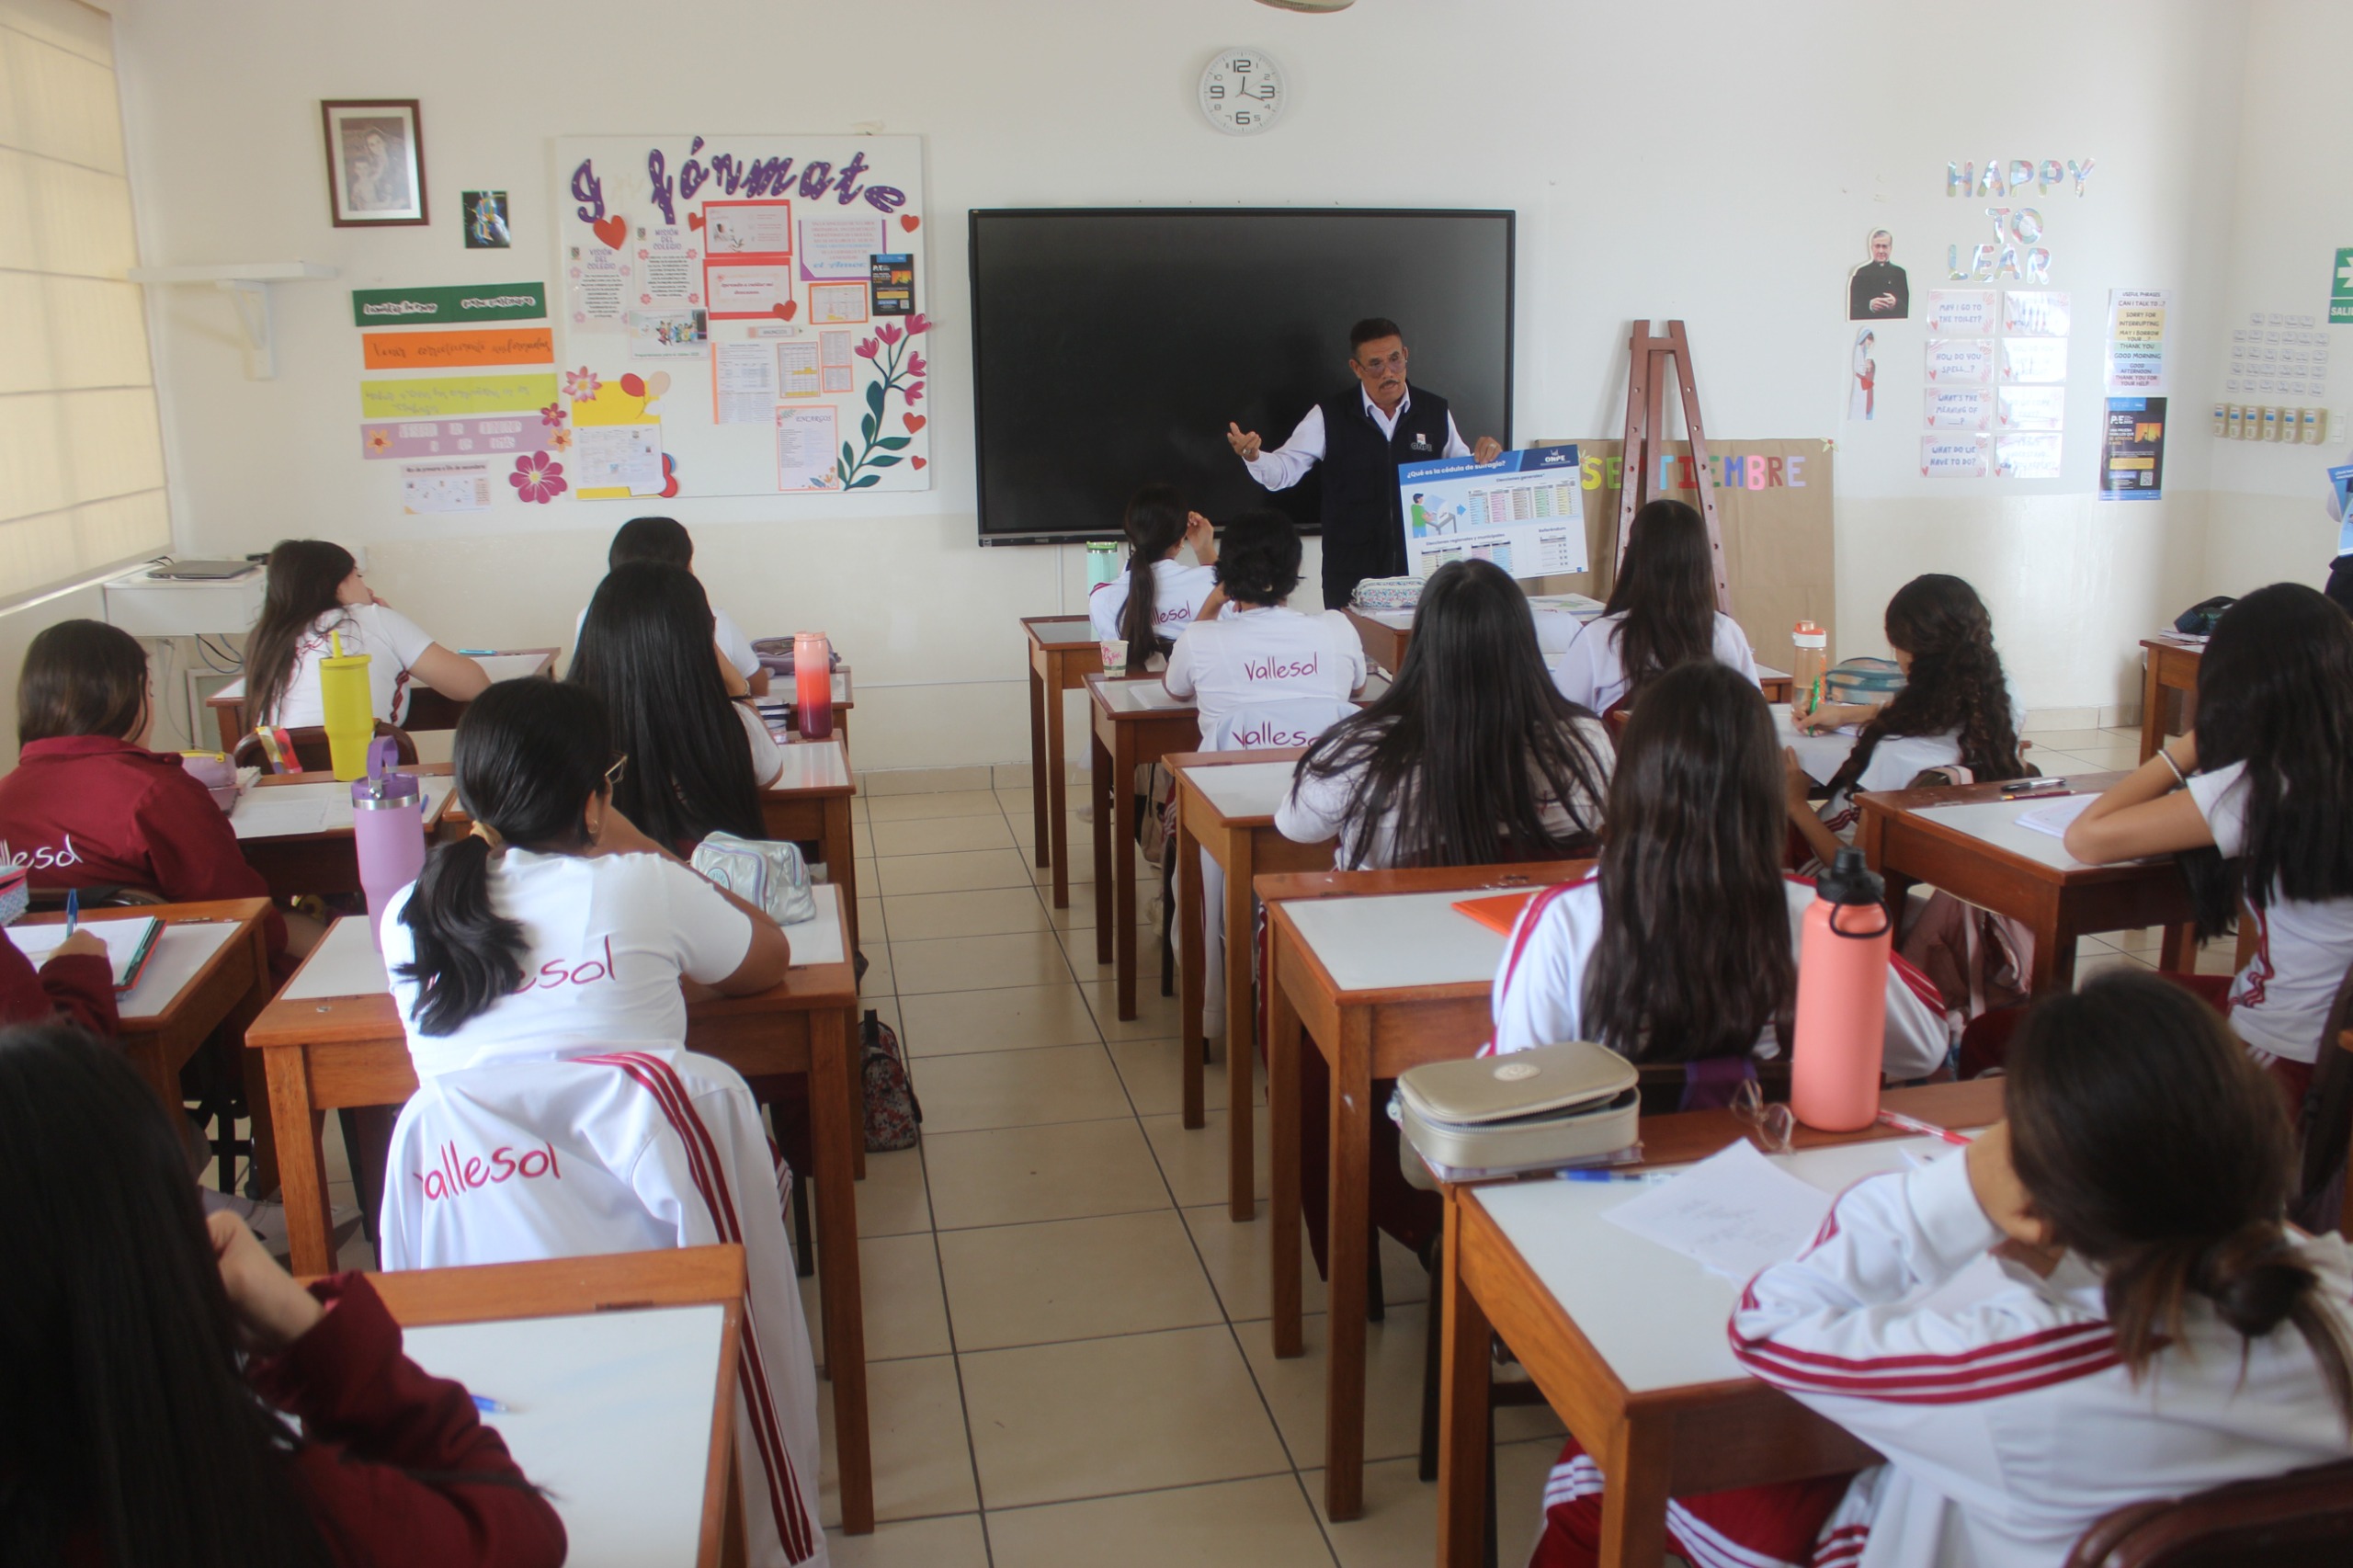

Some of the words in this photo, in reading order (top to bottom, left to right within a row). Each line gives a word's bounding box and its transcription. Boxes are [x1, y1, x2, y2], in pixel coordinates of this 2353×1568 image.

[1233, 59, 1252, 74] 12
[1210, 85, 1225, 99] 9
[1260, 85, 1276, 99] 3
[1235, 111, 1251, 125] 6
[1946, 158, 2096, 199] HAPPY
[1985, 207, 2043, 244] TO
[1948, 244, 2052, 285] LEAR
[2331, 307, 2353, 316] SALI
[795, 415, 832, 424] ENCARGOS
[1544, 455, 1566, 463] ONPE
[1406, 469, 1424, 479] ¿Qué
[1440, 465, 1464, 473] cédula
[1580, 455, 1807, 490] SETIEMBRE
[1151, 600, 1191, 626] llesol
[1244, 651, 1318, 681] Vallesol
[0, 833, 84, 869] llesol
